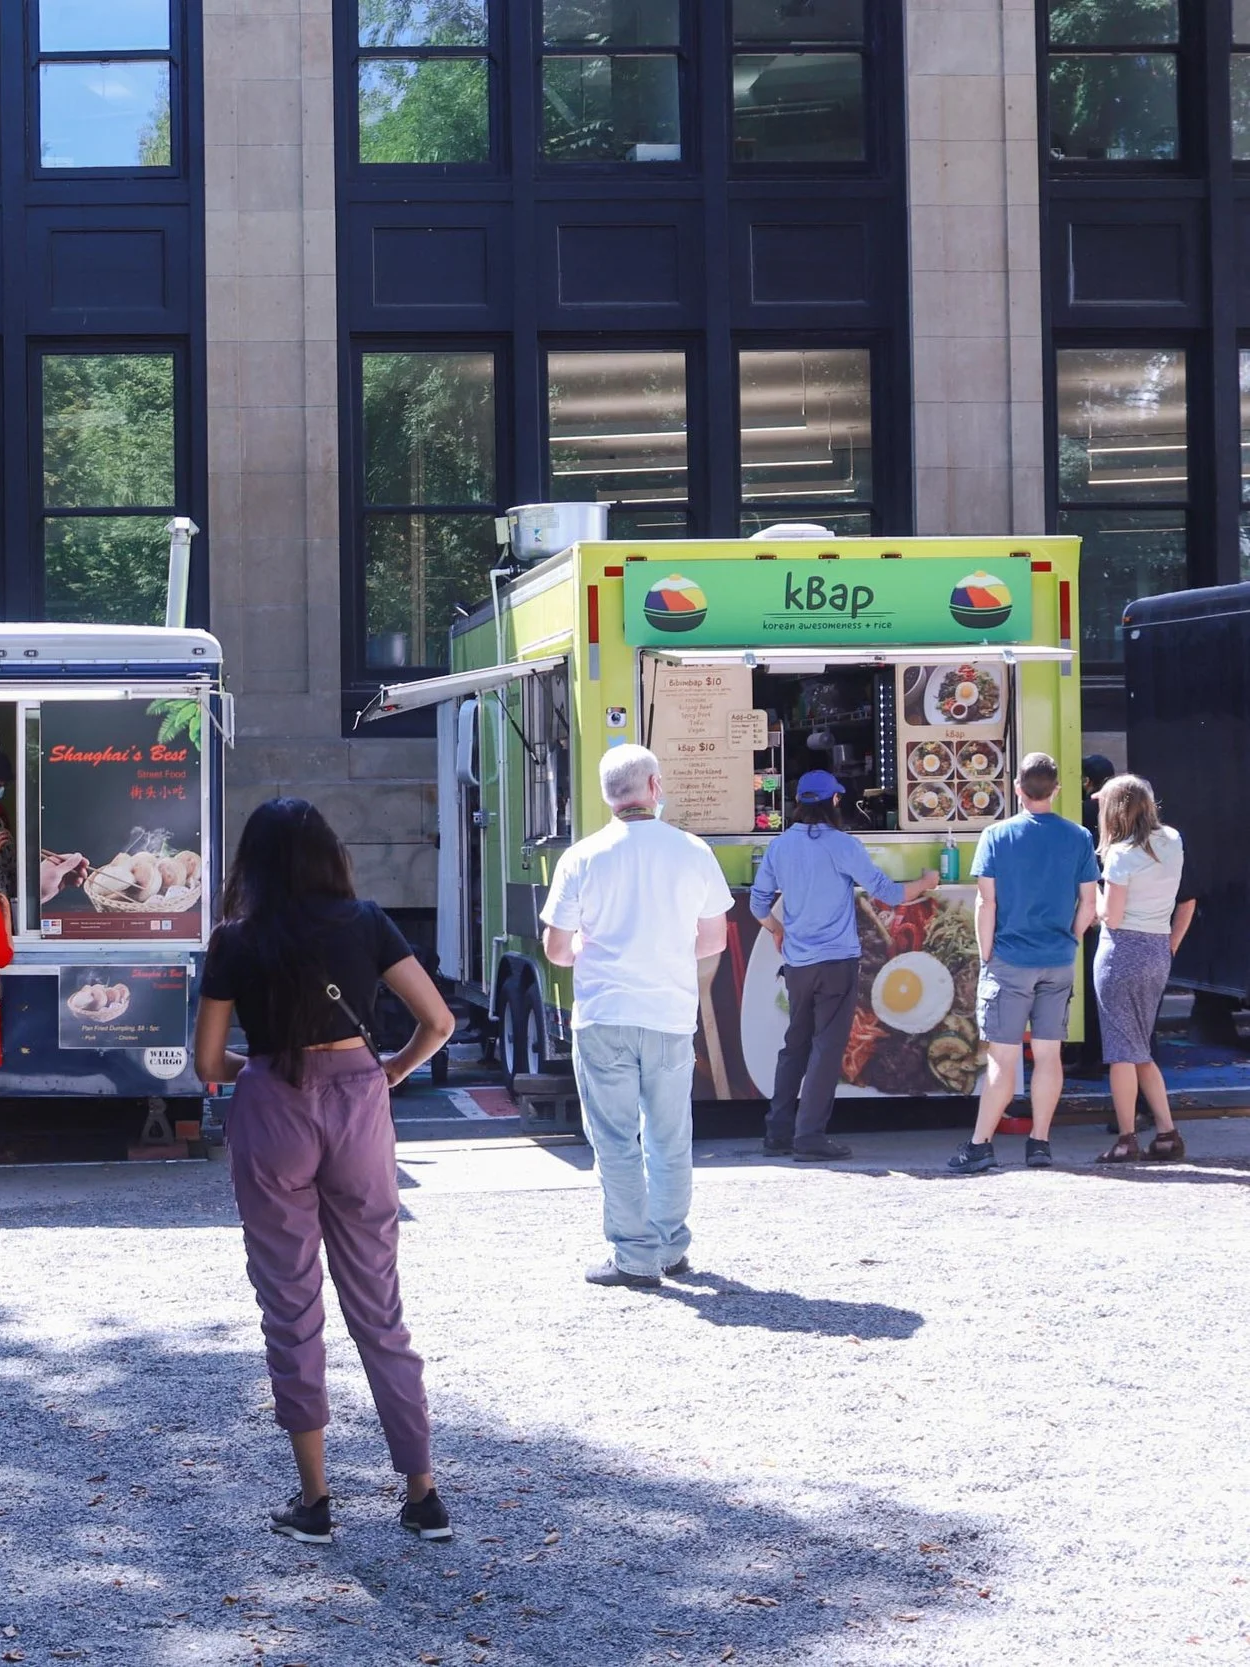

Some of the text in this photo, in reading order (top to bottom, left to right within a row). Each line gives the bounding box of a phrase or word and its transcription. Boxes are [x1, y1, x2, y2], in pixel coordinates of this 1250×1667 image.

[784, 571, 874, 619] kBap
[762, 620, 795, 631] korean
[798, 621, 862, 631] awesomeness
[873, 621, 893, 630] rice
[705, 676, 722, 686] $10
[698, 742, 715, 752] $10
[49, 744, 188, 767] Shanghai's Best
[164, 769, 186, 779] Food
[129, 785, 187, 800] 街头小吃
[150, 1050, 183, 1058] WELLS
